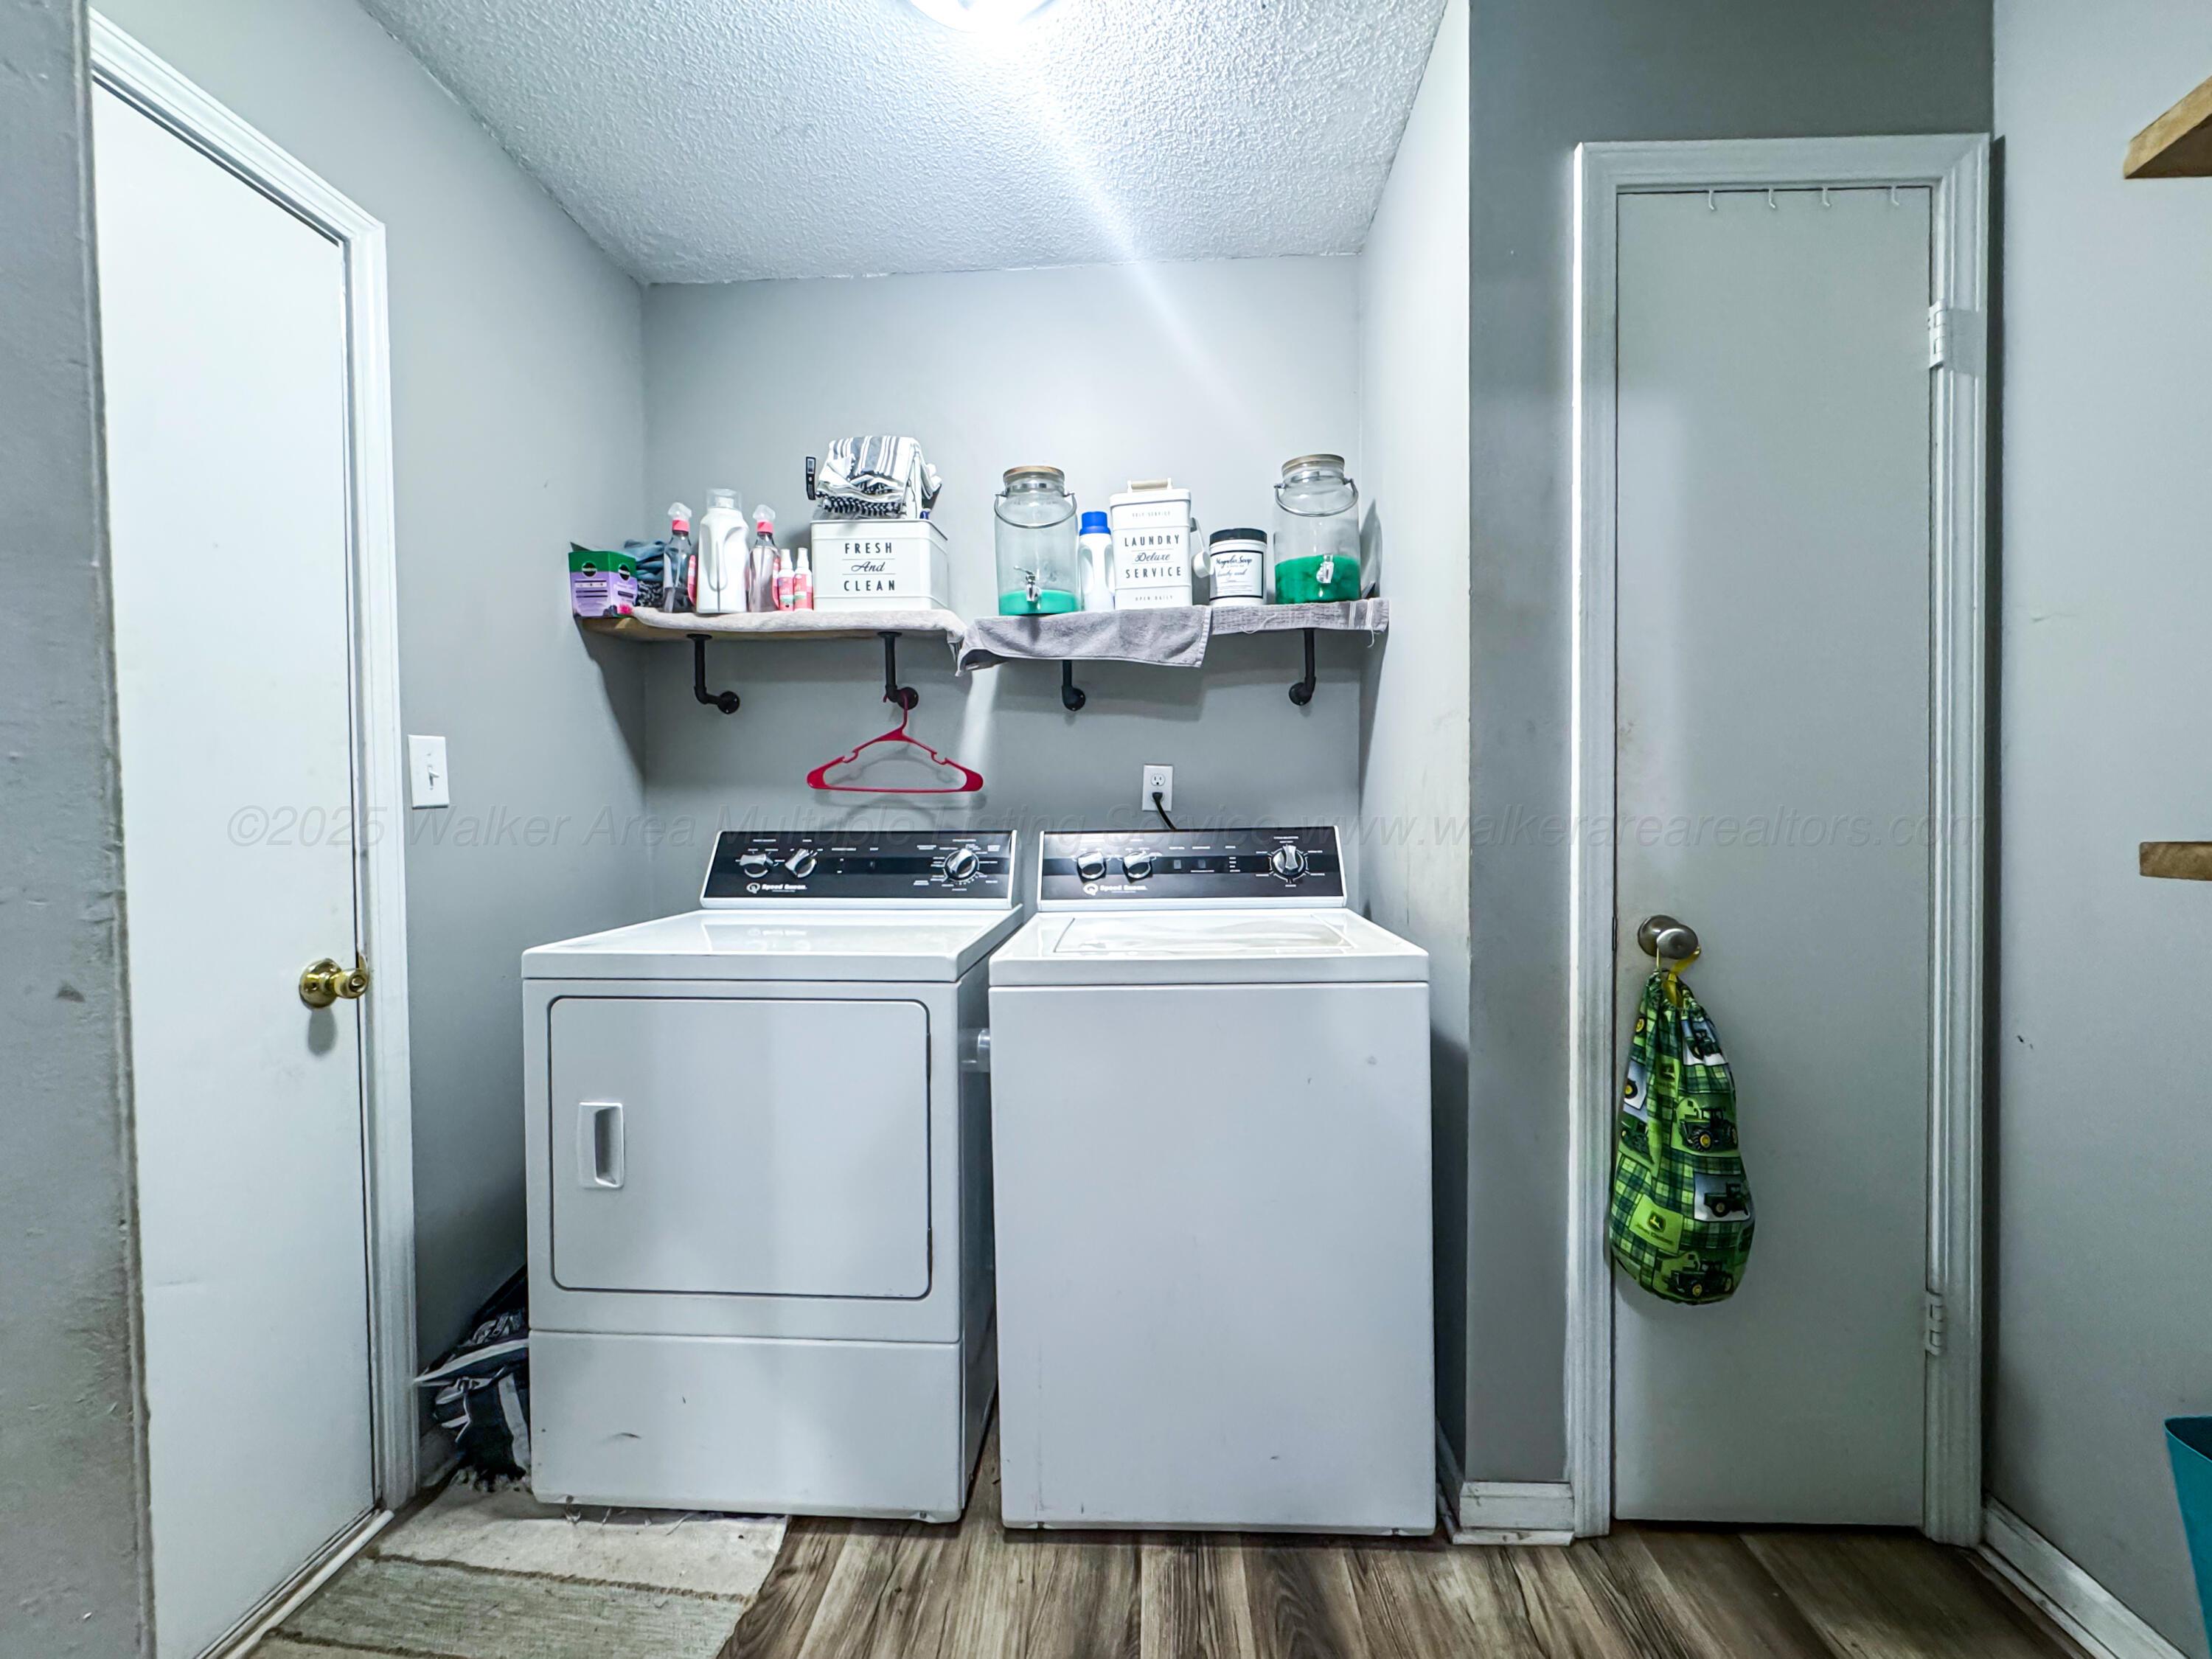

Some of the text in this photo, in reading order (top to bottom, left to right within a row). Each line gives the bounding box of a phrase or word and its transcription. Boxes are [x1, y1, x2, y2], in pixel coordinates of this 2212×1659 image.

[1124, 535, 1180, 546] LAUNDRY
[844, 542, 892, 554] FRESH
[1135, 552, 1171, 562] Deluxe
[851, 560, 886, 572] And
[1125, 566, 1181, 579] SERVICE
[844, 580, 895, 591] CLEAN
